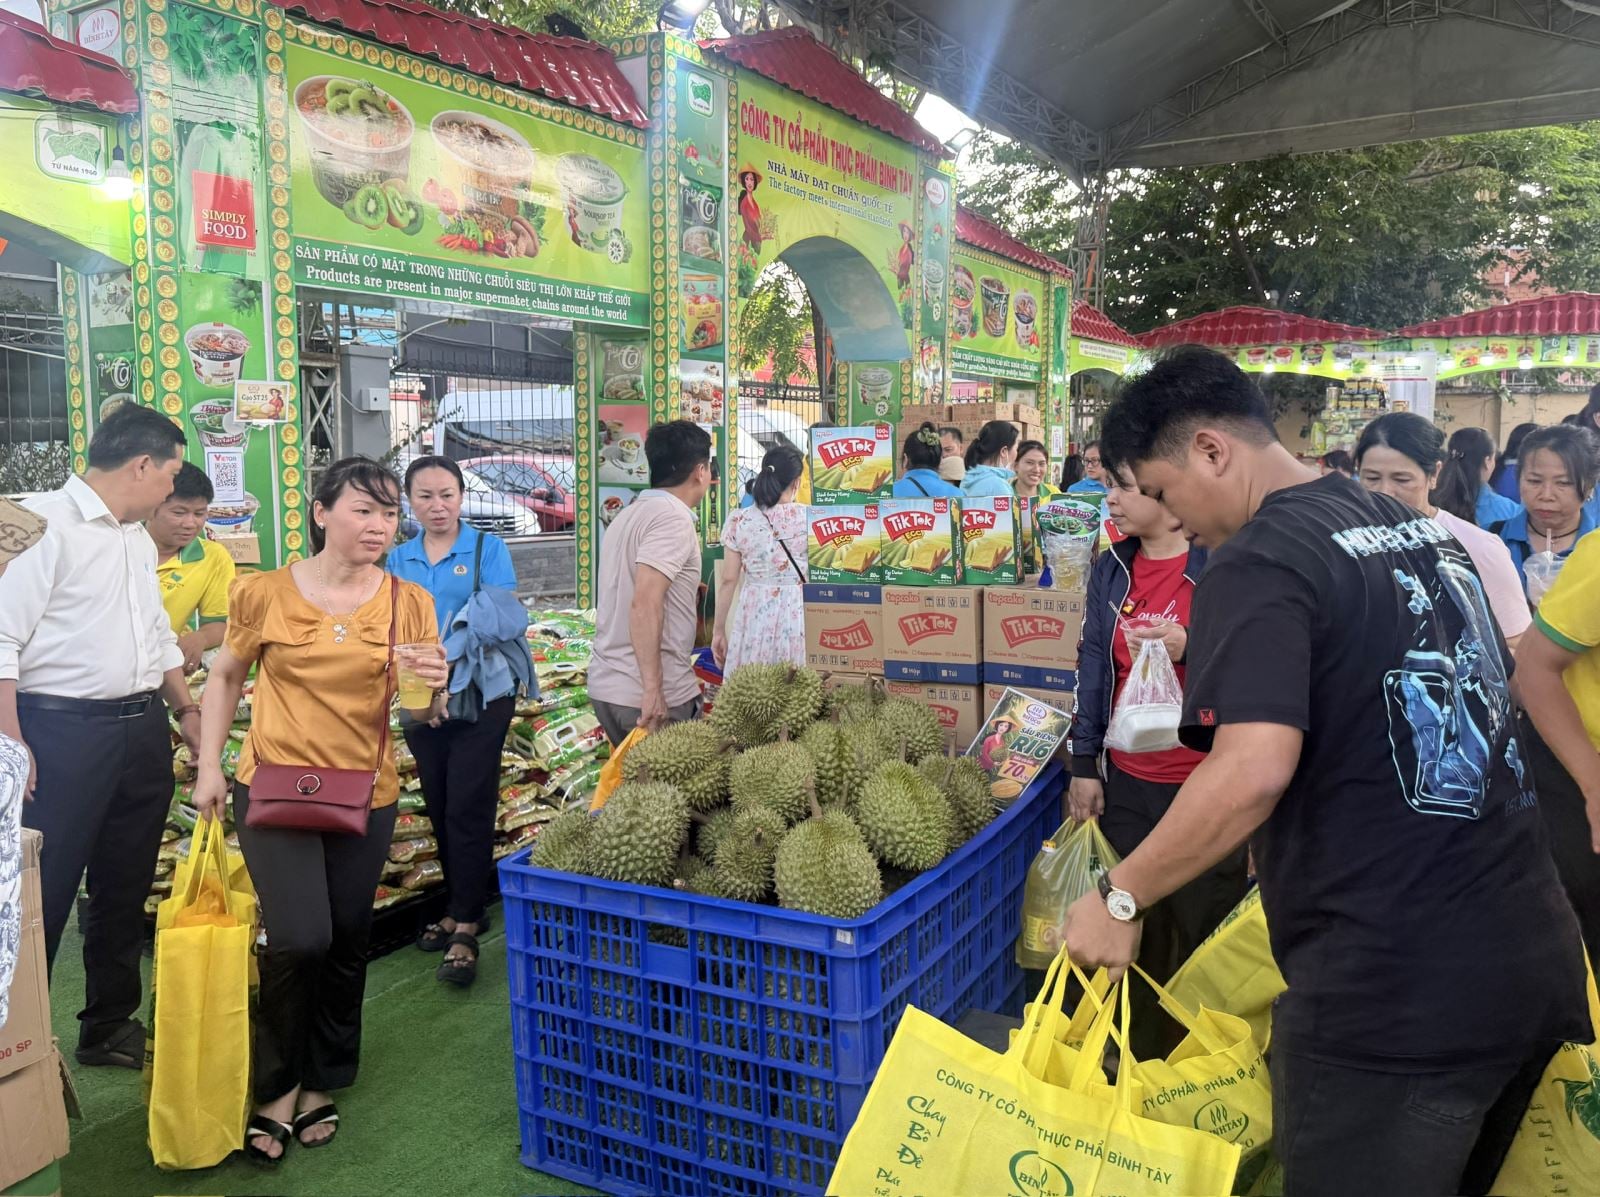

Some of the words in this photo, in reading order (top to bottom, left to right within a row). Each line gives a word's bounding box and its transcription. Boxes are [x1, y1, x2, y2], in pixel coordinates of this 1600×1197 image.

[741, 97, 770, 143] CÔNG
[773, 115, 786, 148] TY
[788, 111, 801, 155] CỔ
[804, 122, 828, 166] PHẦN
[831, 141, 853, 181] THỰC
[855, 144, 877, 185] PHẨM
[879, 156, 897, 192] BÌNH
[899, 166, 913, 198] TÂY
[768, 160, 787, 176] NHÀ
[790, 168, 809, 184] MÁY
[812, 177, 829, 192] ĐẠT
[831, 184, 859, 202] CHUẨN
[861, 195, 880, 210] QUỐC
[884, 203, 893, 213] TẾ
[769, 176, 781, 190] The
[784, 181, 807, 201] factory
[808, 192, 828, 206] meets
[829, 197, 867, 218] international
[867, 212, 893, 227] standards
[201, 208, 246, 225] SIMPLY
[203, 221, 247, 240] FOOD
[295, 241, 321, 260] SẢN
[324, 245, 359, 266] PHẨM
[362, 253, 378, 268] CÓ
[381, 257, 406, 274] MẶT
[409, 262, 444, 279] TRONG
[448, 267, 482, 285] NHỮNG
[485, 271, 514, 289] CHUỖI
[516, 279, 537, 292] SIÊU
[539, 283, 554, 297] THỊ
[556, 284, 572, 298] LỚN
[574, 286, 596, 301] KHẮP
[597, 289, 613, 303] THẾ
[615, 293, 631, 306] GIỚI
[306, 265, 360, 285] Products
[364, 275, 383, 288] are
[386, 278, 427, 294] present
[430, 283, 441, 295] in
[444, 286, 472, 302] major
[475, 289, 530, 308] supermaket
[532, 298, 560, 312] chains
[561, 303, 589, 316] around
[591, 306, 604, 317] the
[606, 308, 627, 320] world
[823, 441, 850, 459] Tik
[848, 440, 872, 453] Tok
[816, 520, 841, 537] Tik
[840, 518, 861, 531] Tok
[888, 513, 911, 531] Tik
[910, 513, 932, 526] Tok
[969, 511, 992, 525] Tok
[904, 616, 930, 635] Tik
[928, 615, 953, 630] Tok
[1007, 619, 1034, 637] Tik
[1034, 618, 1061, 635] Tok
[1034, 731, 1058, 743] RIÊNG
[16, 1040, 32, 1053] SP
[1142, 1097, 1155, 1112] TY
[1156, 1087, 1171, 1105] CỔ
[1203, 1075, 1237, 1093] PHẨM
[907, 1095, 947, 1138] Chay
[936, 1068, 975, 1094] CÔNG
[978, 1088, 994, 1103] TY
[995, 1098, 1016, 1116] CỔ
[1017, 1109, 1035, 1128] PH
[1036, 1126, 1072, 1148] THỰC
[1075, 1139, 1104, 1159] PHẨ
[1107, 1151, 1142, 1174] BÌNH
[1145, 1166, 1173, 1185] TÂY
[907, 1120, 931, 1143] Bồ
[897, 1143, 924, 1169] Đề
